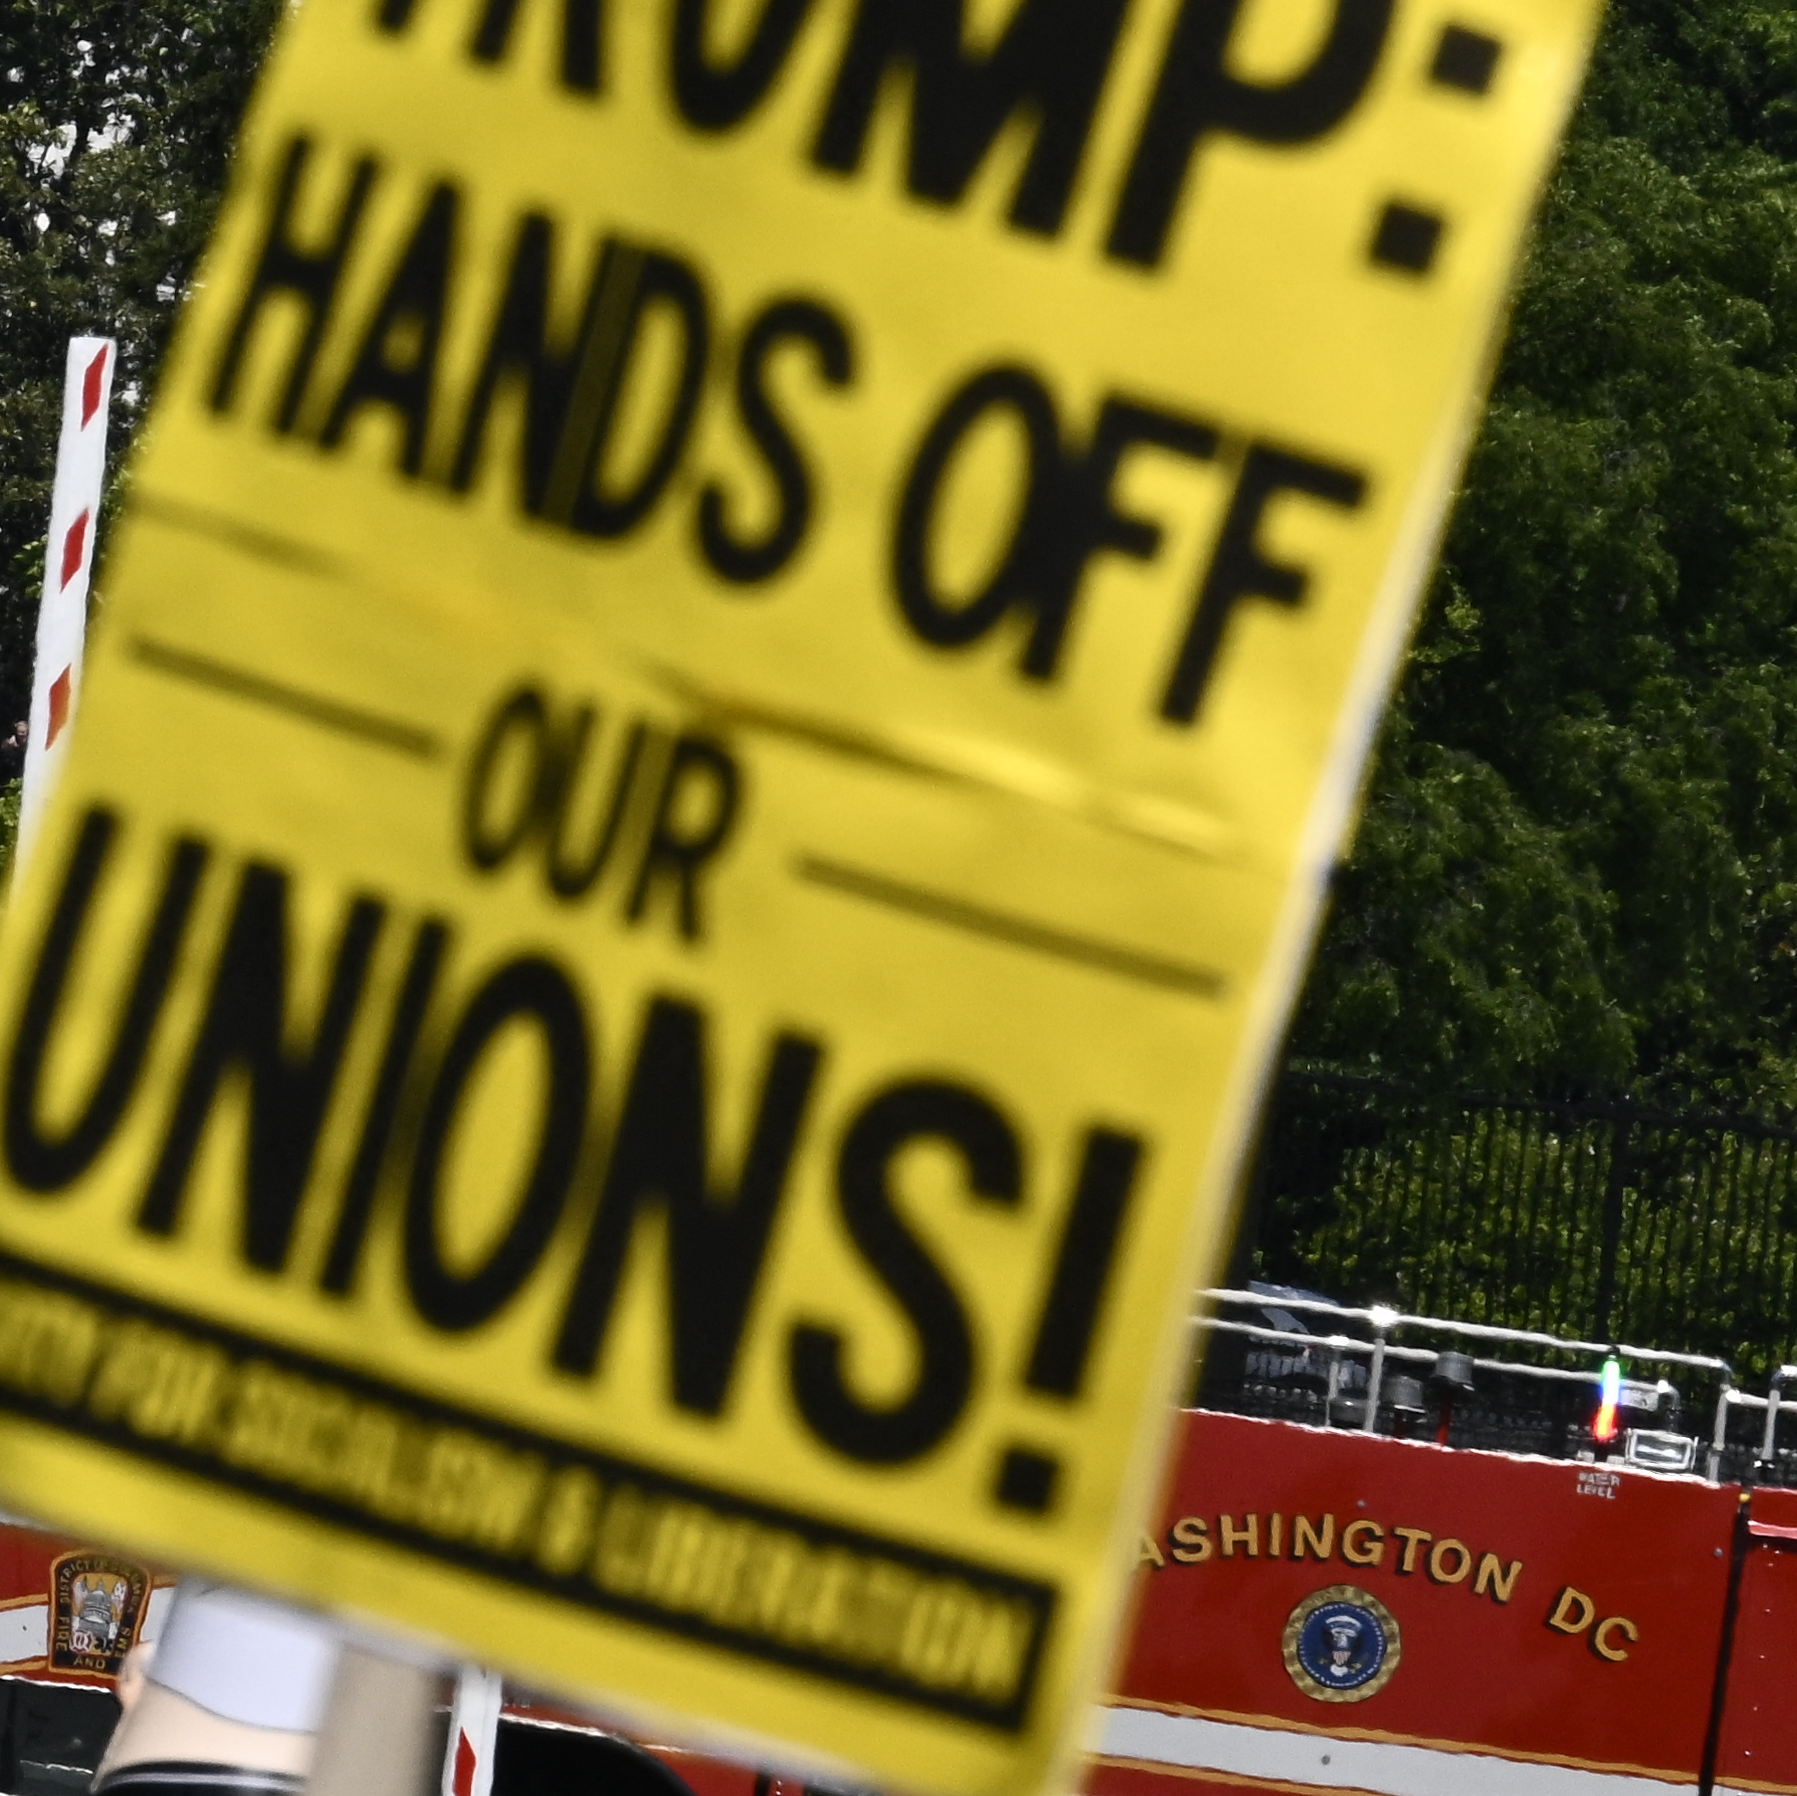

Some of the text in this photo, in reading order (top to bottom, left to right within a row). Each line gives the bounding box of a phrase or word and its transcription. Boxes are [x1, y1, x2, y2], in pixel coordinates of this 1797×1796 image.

[206, 133, 1368, 722] HANDS OFF
[461, 684, 744, 941] OUR
[55, 1616, 70, 1652] FIRE
[73, 1655, 107, 1670] AND
[1136, 1513, 1639, 1662] ASHINGTON DC
